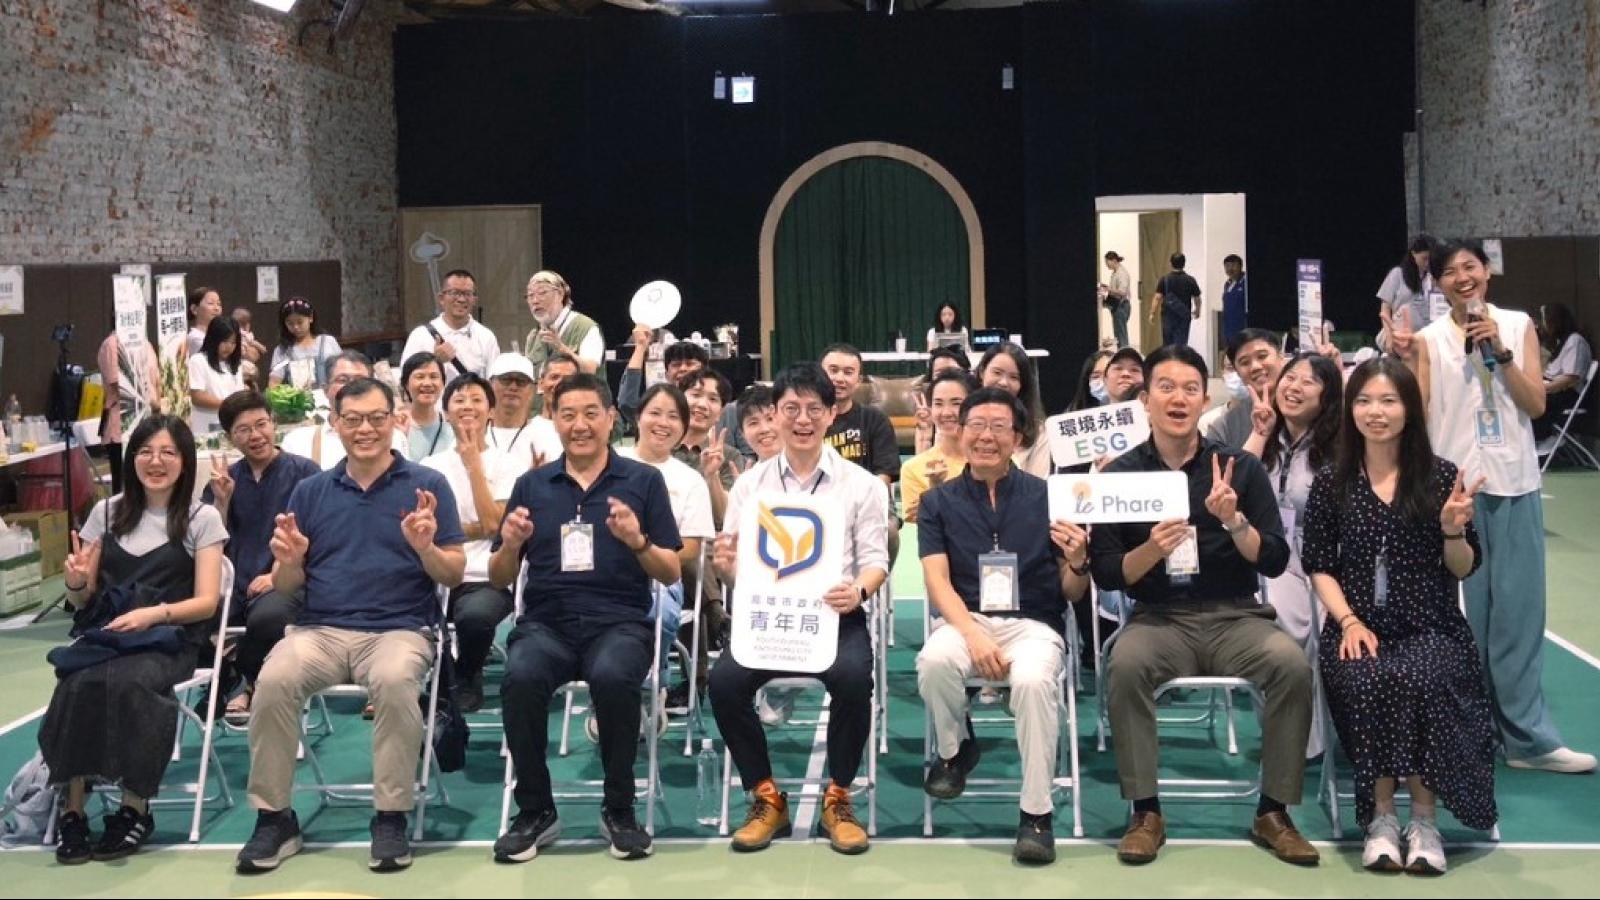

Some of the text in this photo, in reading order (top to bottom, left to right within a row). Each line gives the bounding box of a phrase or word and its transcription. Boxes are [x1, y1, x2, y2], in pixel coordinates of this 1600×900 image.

[1058, 407, 1134, 437] 環境永續
[1075, 432, 1128, 459] ESG
[1102, 495, 1164, 513] Phare
[750, 610, 820, 635] 青年局
